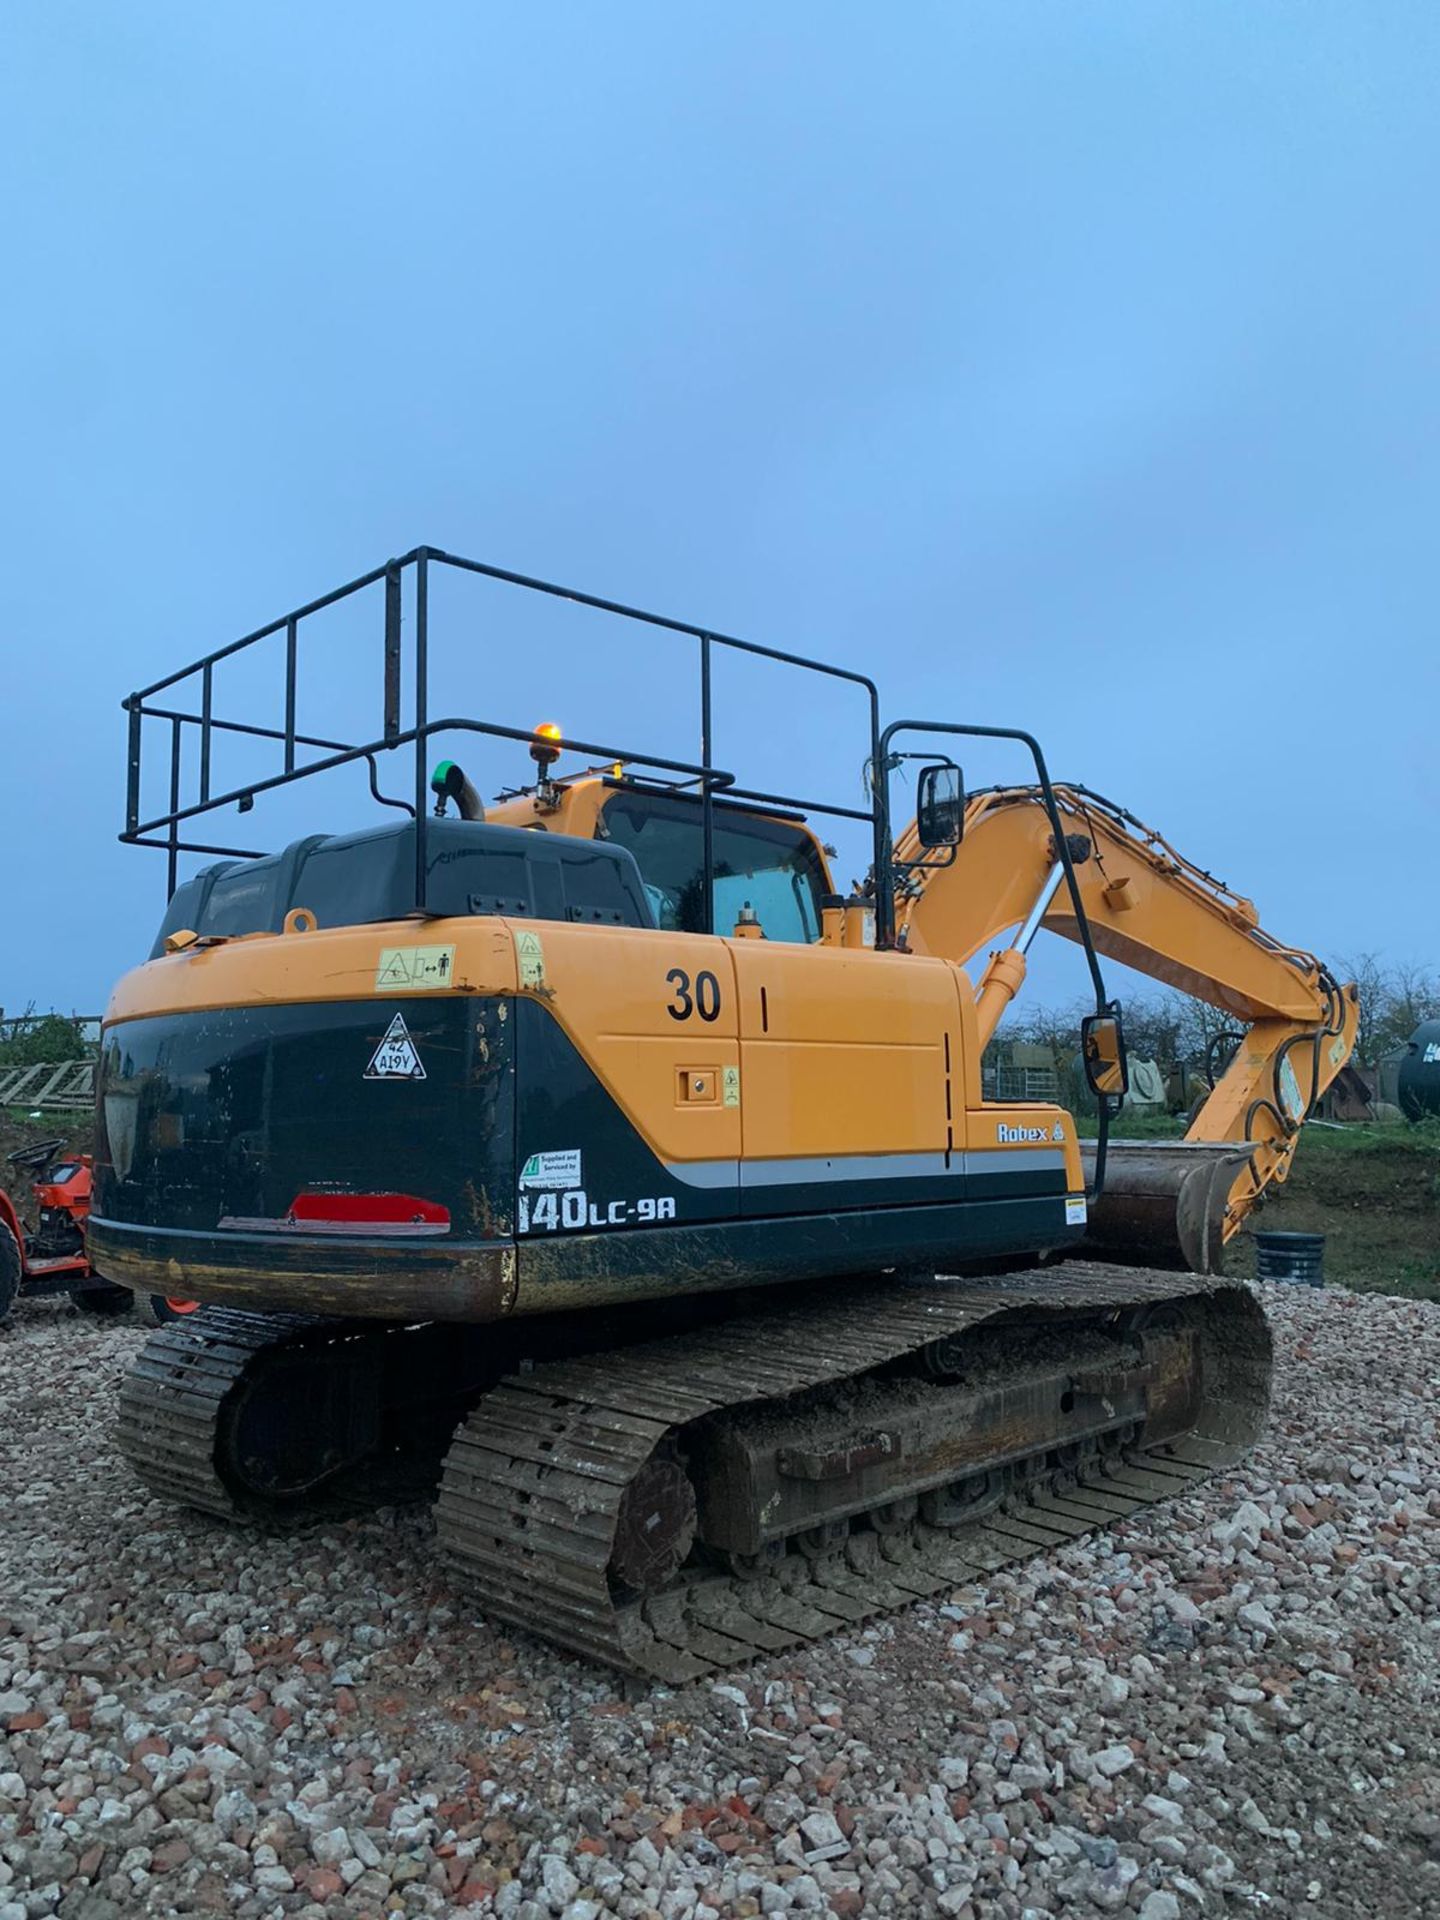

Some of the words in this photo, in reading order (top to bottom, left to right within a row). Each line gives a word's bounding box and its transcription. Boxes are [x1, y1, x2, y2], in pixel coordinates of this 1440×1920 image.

[666, 968, 720, 1022] 30
[998, 1123, 1048, 1143] Robex
[541, 1155, 566, 1163] Supplied
